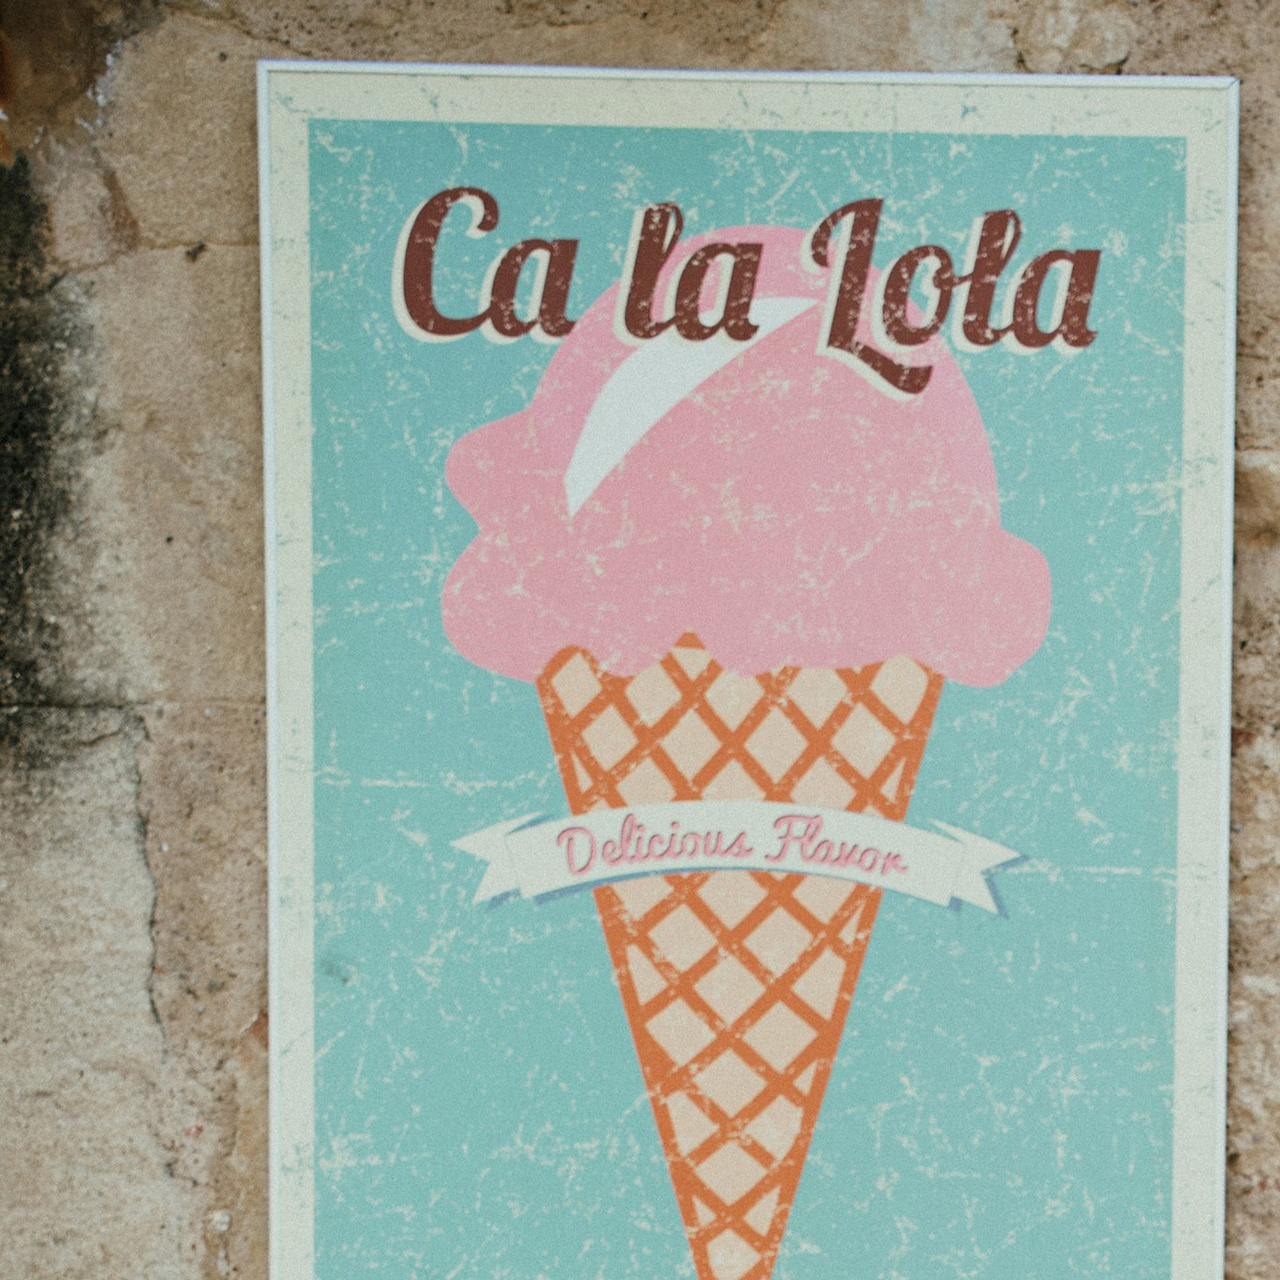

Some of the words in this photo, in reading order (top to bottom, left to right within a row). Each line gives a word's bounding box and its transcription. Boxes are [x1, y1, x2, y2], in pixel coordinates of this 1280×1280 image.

[392, 186, 580, 342] Ca
[615, 202, 764, 346] la
[800, 196, 1102, 401] Lola
[556, 812, 753, 875] Delicious
[764, 814, 908, 876] Flavor
